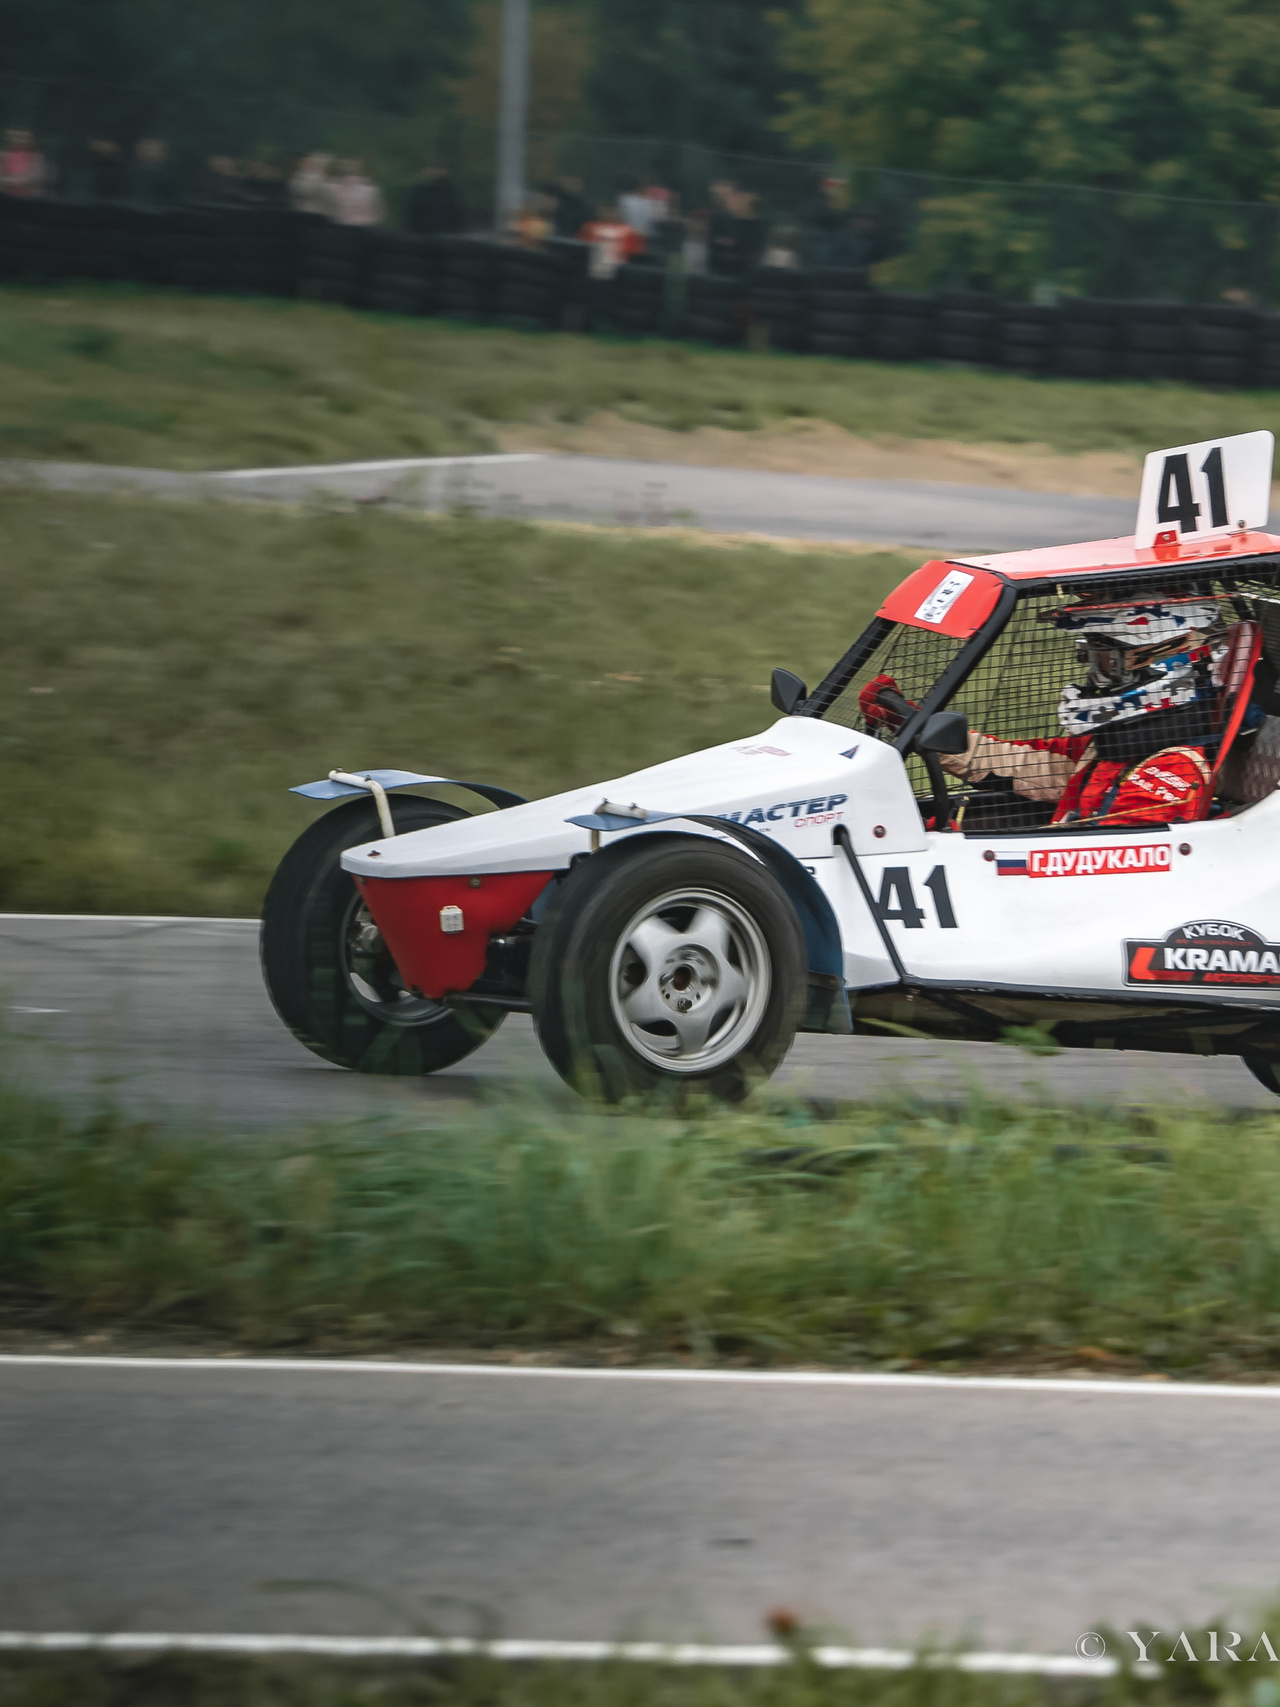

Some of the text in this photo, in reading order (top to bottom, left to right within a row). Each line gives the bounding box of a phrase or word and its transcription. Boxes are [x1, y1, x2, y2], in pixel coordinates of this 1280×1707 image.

[1157, 446, 1230, 534] 41
[793, 811, 845, 828] СПОРТ
[1032, 846, 1171, 876] Г.ДУДУКАЛО
[879, 864, 959, 929] 41
[1182, 923, 1246, 941] КУБОК
